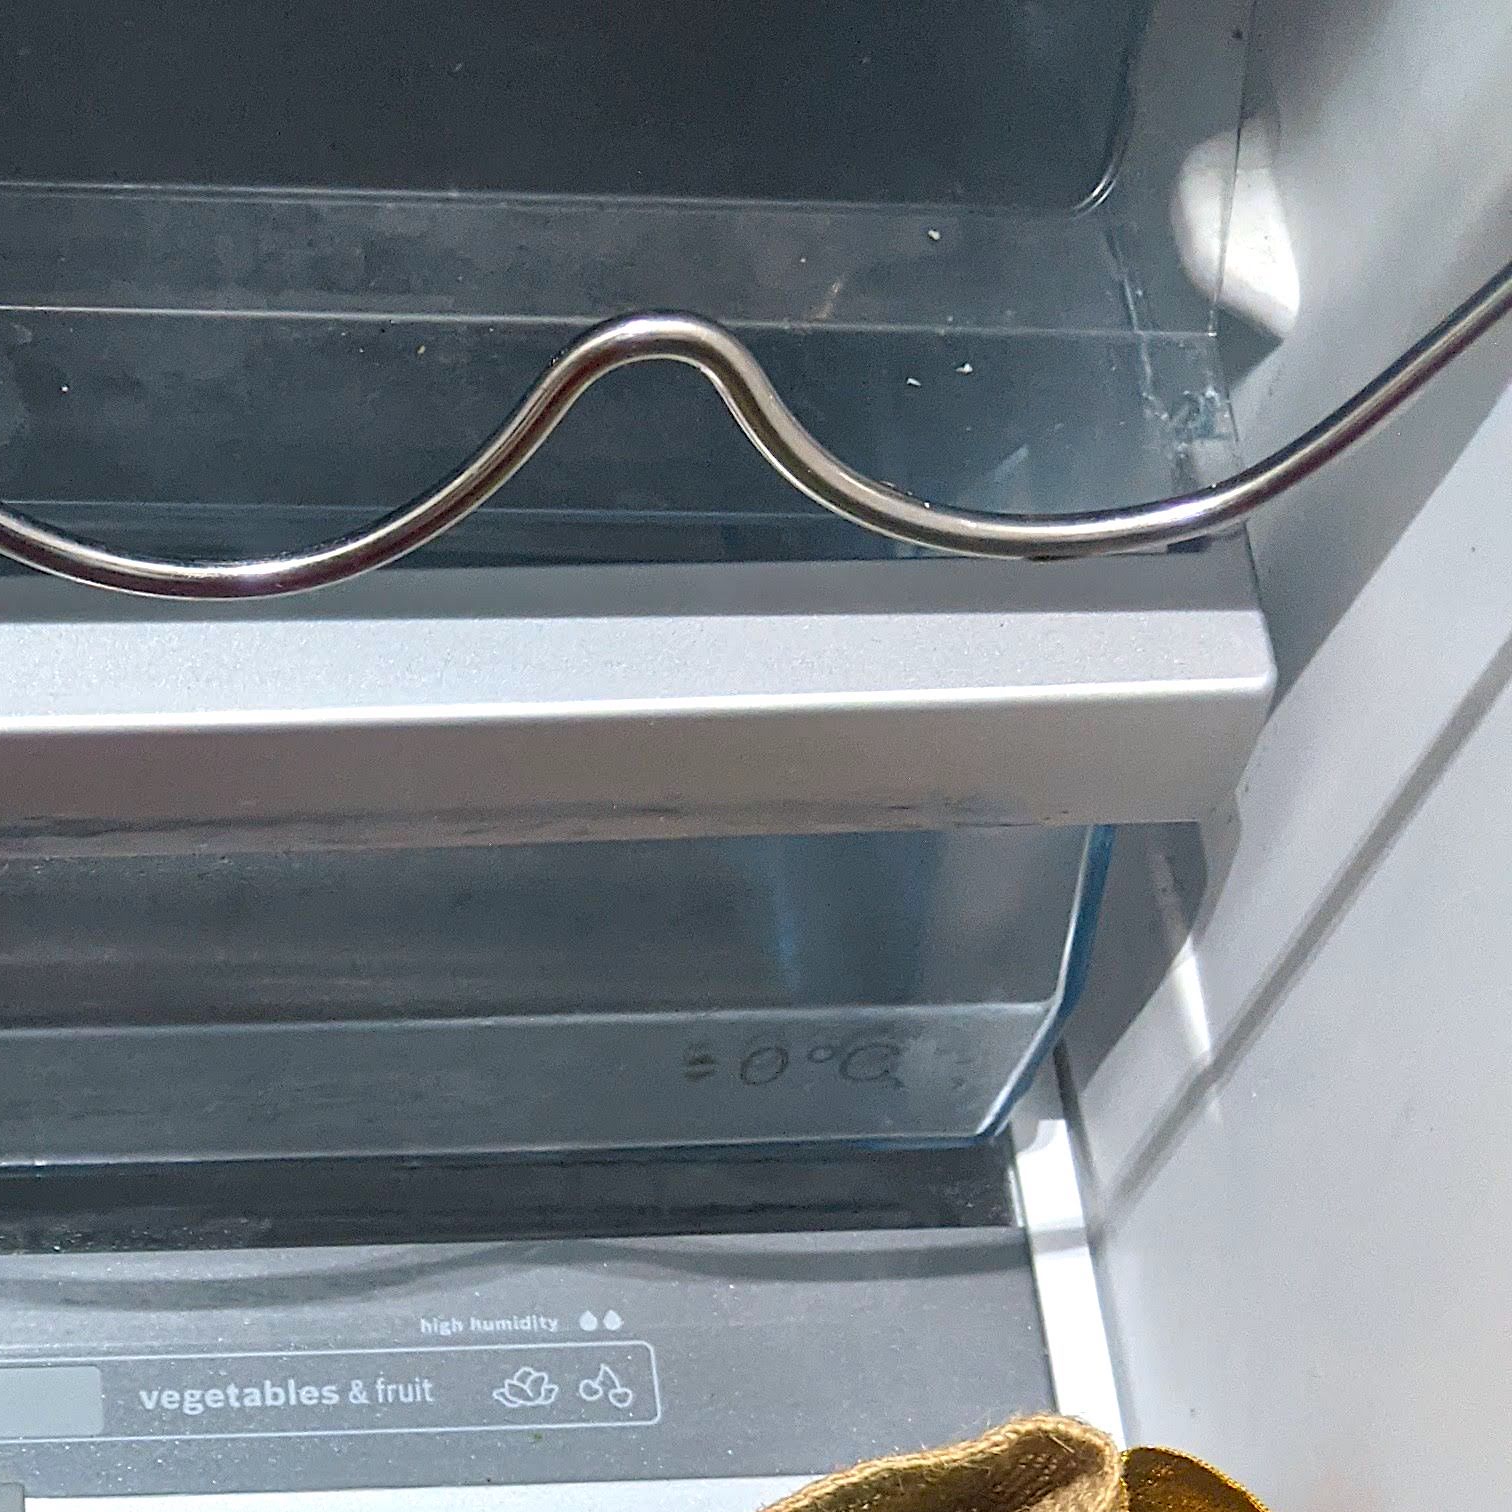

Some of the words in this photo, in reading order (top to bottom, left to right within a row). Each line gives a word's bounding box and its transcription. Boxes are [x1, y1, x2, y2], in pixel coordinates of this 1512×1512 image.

[420, 1319, 464, 1336] high
[471, 1315, 559, 1333] humidity
[138, 1379, 339, 1416] vegetables
[348, 1379, 370, 1404] &
[375, 1376, 434, 1403] fruit
